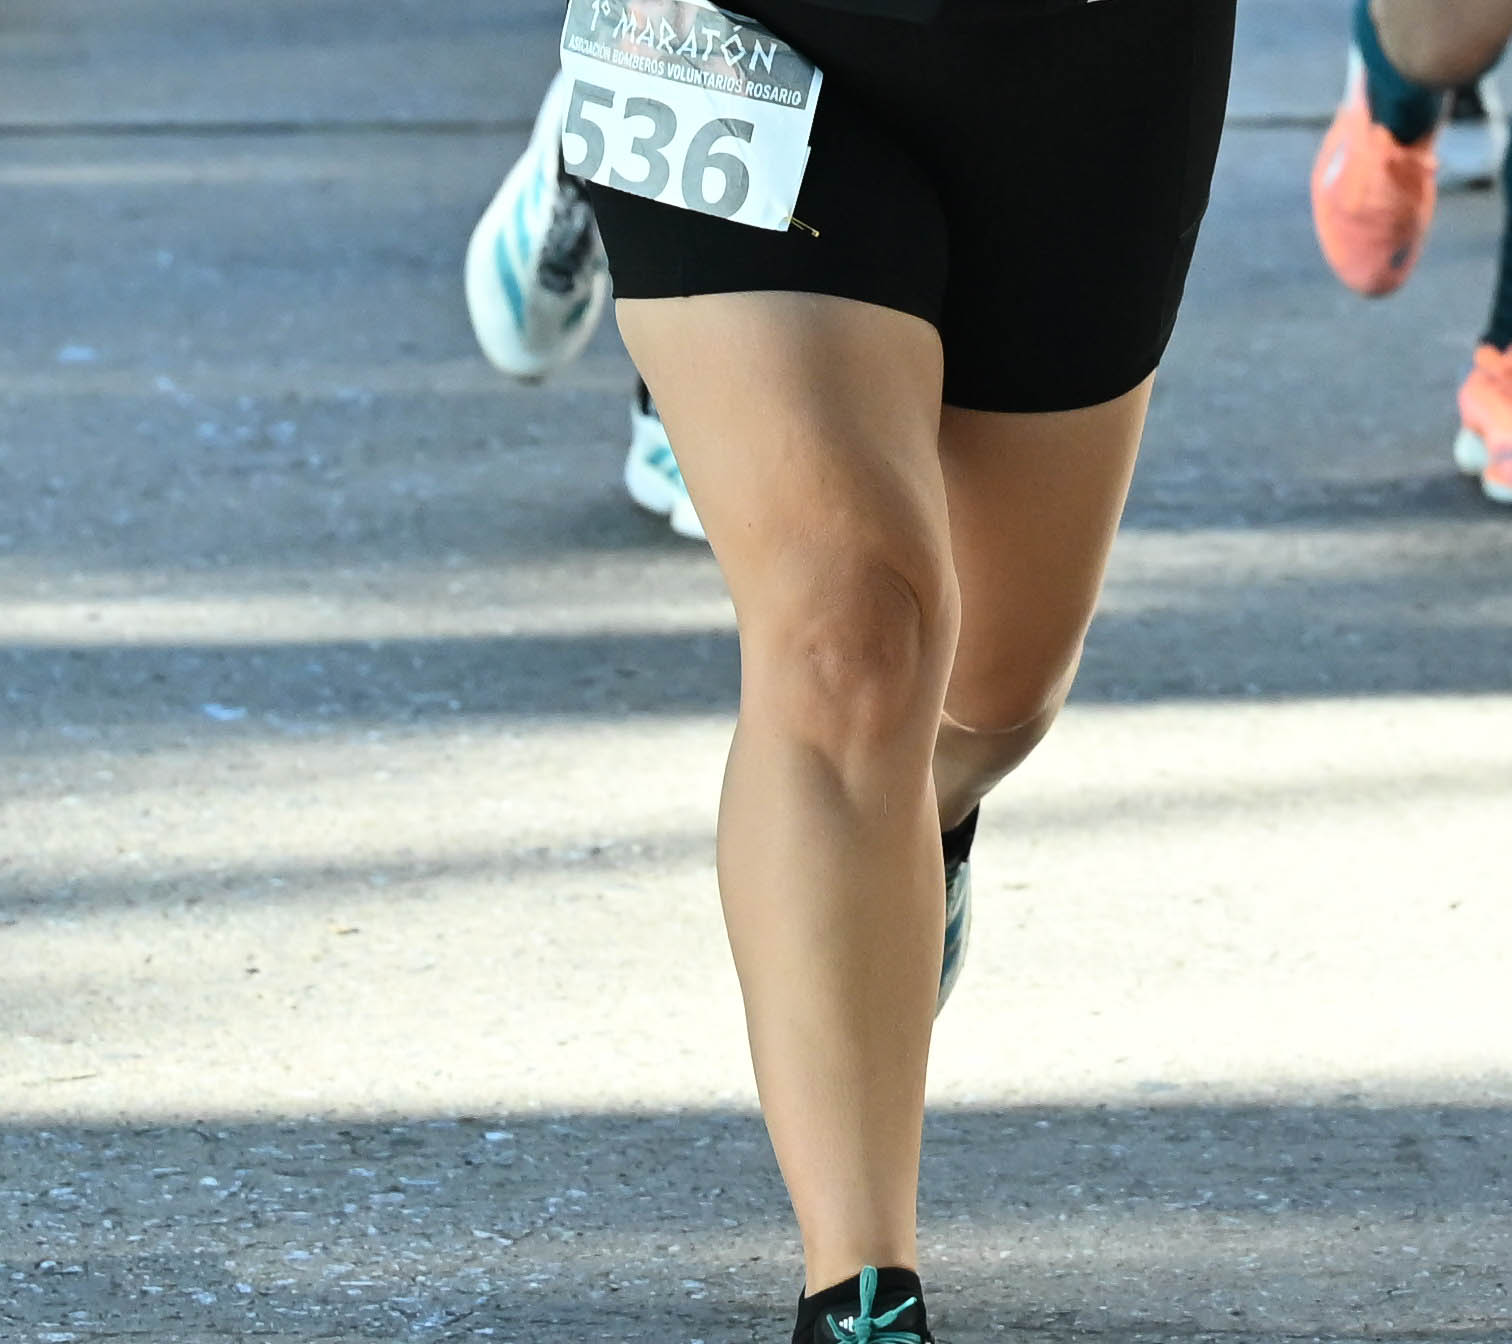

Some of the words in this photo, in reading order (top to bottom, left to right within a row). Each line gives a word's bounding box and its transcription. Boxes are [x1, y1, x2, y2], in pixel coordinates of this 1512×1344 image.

[568, 34, 612, 61] ASOCIACIÓN
[612, 48, 666, 75] BOMBEROS
[666, 60, 744, 93] VOLUNTARIOS
[745, 80, 803, 105] ROSARIO
[613, 7, 778, 75] MARATÓN
[564, 79, 756, 219] 536
